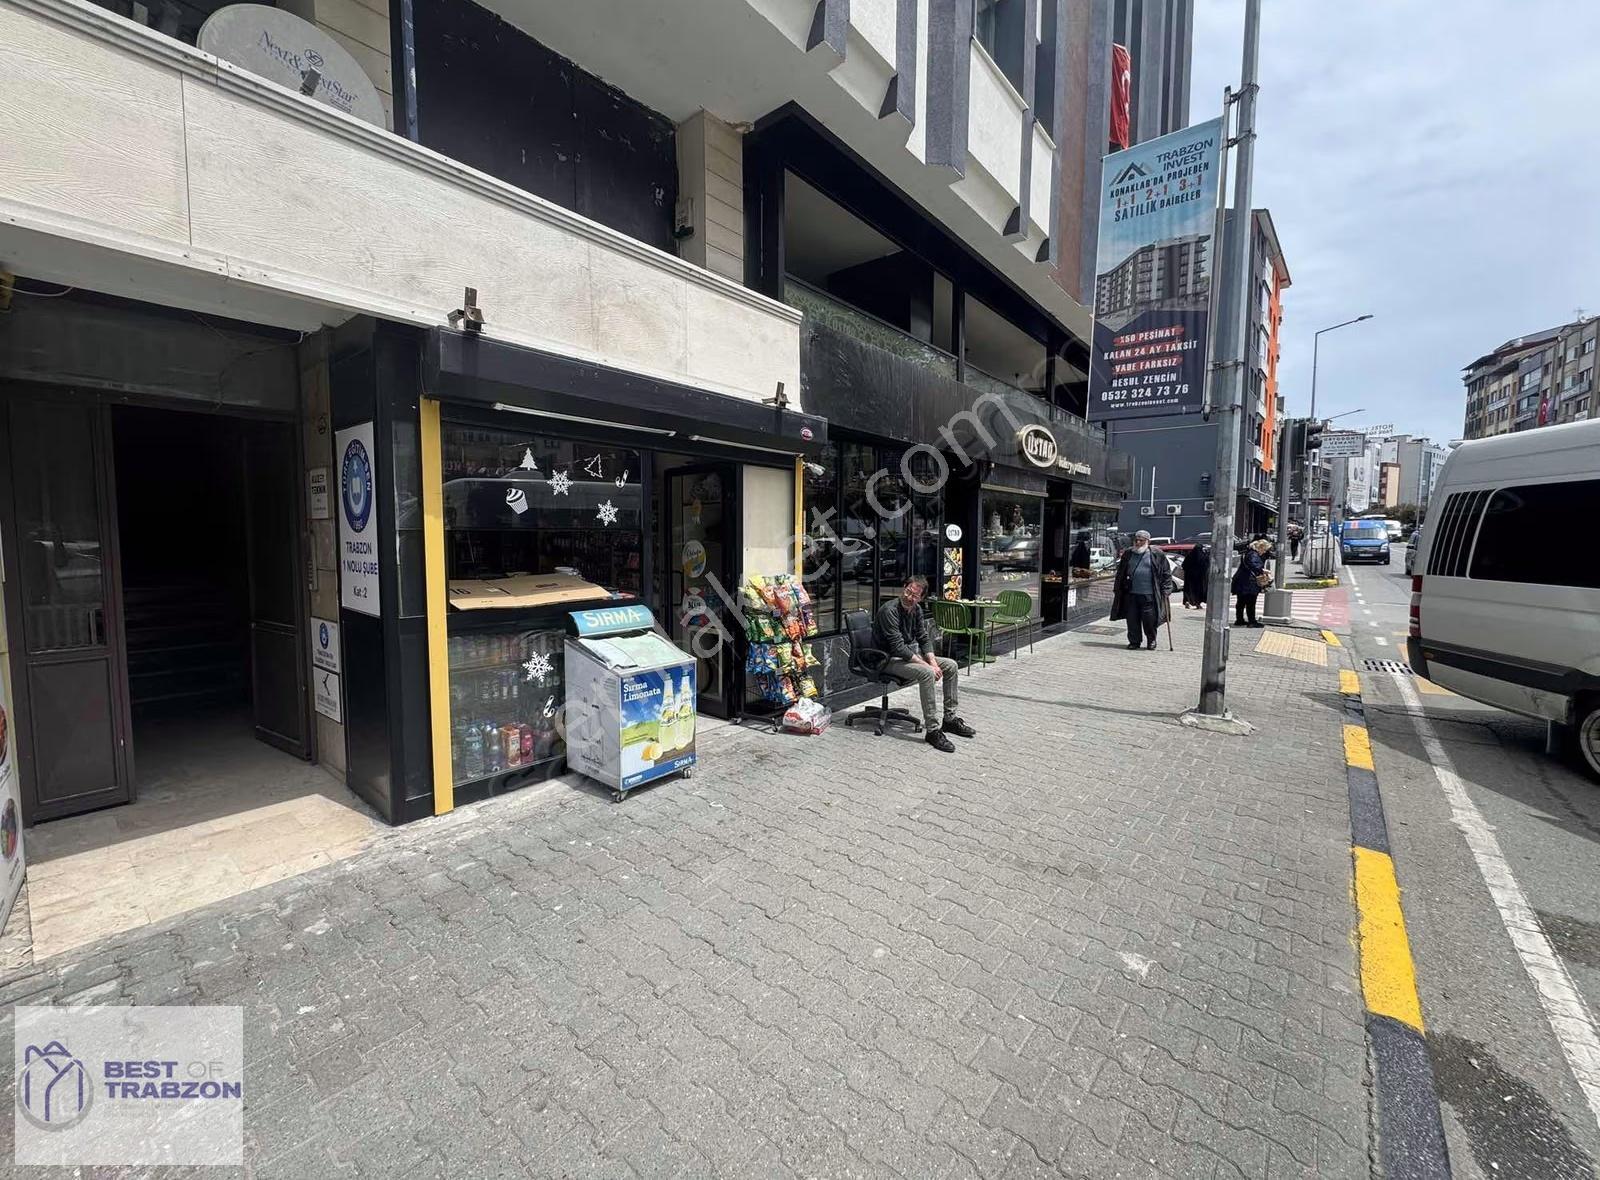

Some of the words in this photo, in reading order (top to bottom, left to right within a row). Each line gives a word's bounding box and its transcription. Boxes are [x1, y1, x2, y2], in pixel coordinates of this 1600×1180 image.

[1156, 138, 1213, 163] TRABZON
[1163, 151, 1205, 171] INVEST
[1110, 177, 1164, 198] KONAKLAR'DA
[1167, 162, 1210, 182] PROJEDEN
[1116, 194, 1136, 209] 1+1
[1146, 184, 1168, 201] 2+1
[1179, 174, 1202, 191] 3+1
[1114, 199, 1157, 222] SATILIK
[1120, 334, 1136, 344] %50
[1104, 349, 1132, 360] KALAN
[1134, 347, 1146, 357] 24
[1149, 345, 1161, 355] AY
[1115, 362, 1137, 373] VADE
[1140, 358, 1178, 370] FARKSIZ
[1112, 377, 1140, 388] RESUL
[1101, 390, 1128, 402] 0532
[1131, 387, 1152, 399] 324
[1157, 385, 1171, 396] 73
[1174, 383, 1189, 395] 76
[346, 541, 372, 554] TRABZON
[347, 560, 362, 573] NOLU
[363, 561, 378, 577] ŞUBE
[583, 608, 642, 628] SIRMA
[623, 688, 661, 702] Limonata
